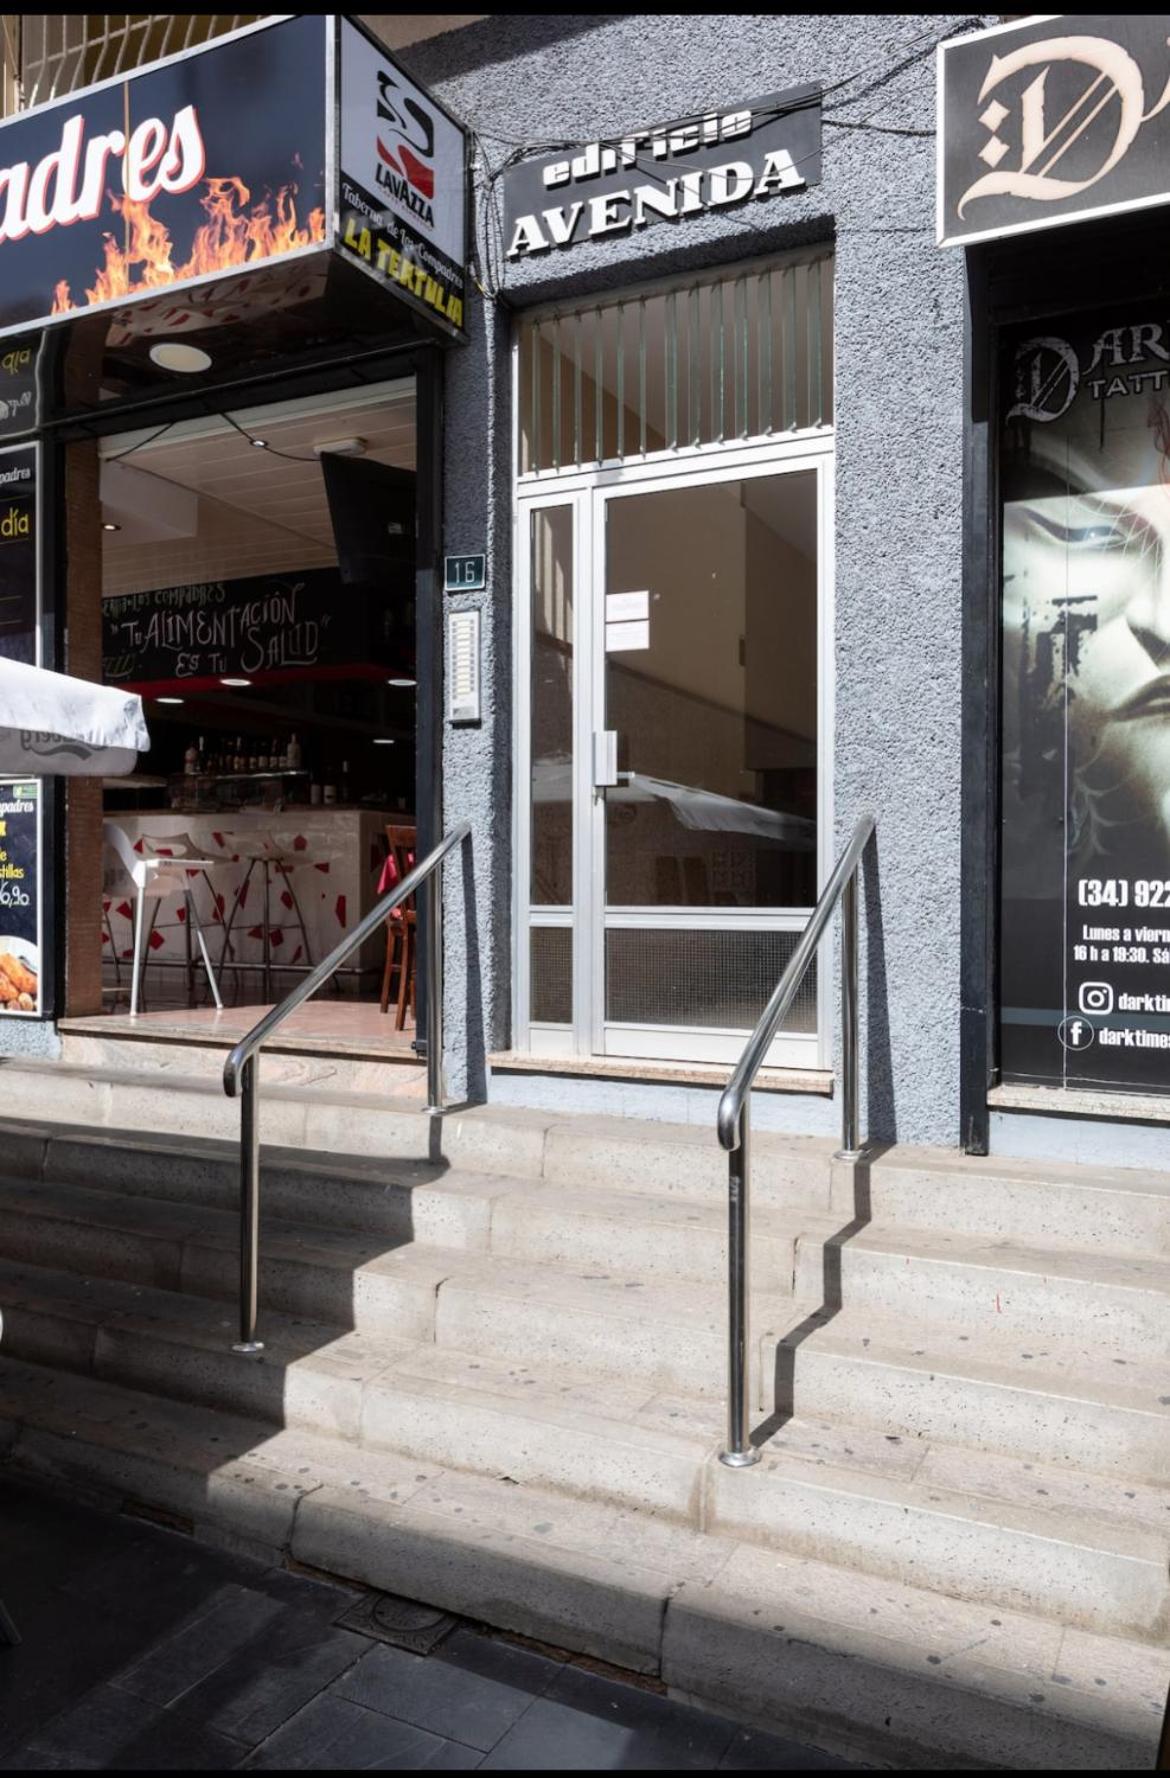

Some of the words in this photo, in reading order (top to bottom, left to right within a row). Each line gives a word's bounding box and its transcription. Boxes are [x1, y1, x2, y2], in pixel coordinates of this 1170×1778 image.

[376, 163, 434, 228] LAVAZZA
[507, 149, 805, 257] AVENIDA
[342, 183, 383, 226] Taberna
[387, 222, 398, 239] de
[417, 243, 463, 289] Compadres
[344, 217, 371, 260] LA
[377, 239, 463, 327] TERTULIA
[1005, 320, 1170, 427] DAR
[1088, 370, 1169, 399] TATT
[1, 507, 29, 536] día
[455, 561, 475, 585] 16
[175, 653, 199, 678] ES
[1078, 879, 1128, 907] (34)
[1083, 924, 1120, 940] Lunes
[1123, 928, 1131, 941] a
[1134, 926, 1170, 942] viern
[1074, 945, 1087, 960] 16
[1090, 945, 1098, 961] h
[1101, 949, 1109, 961] a
